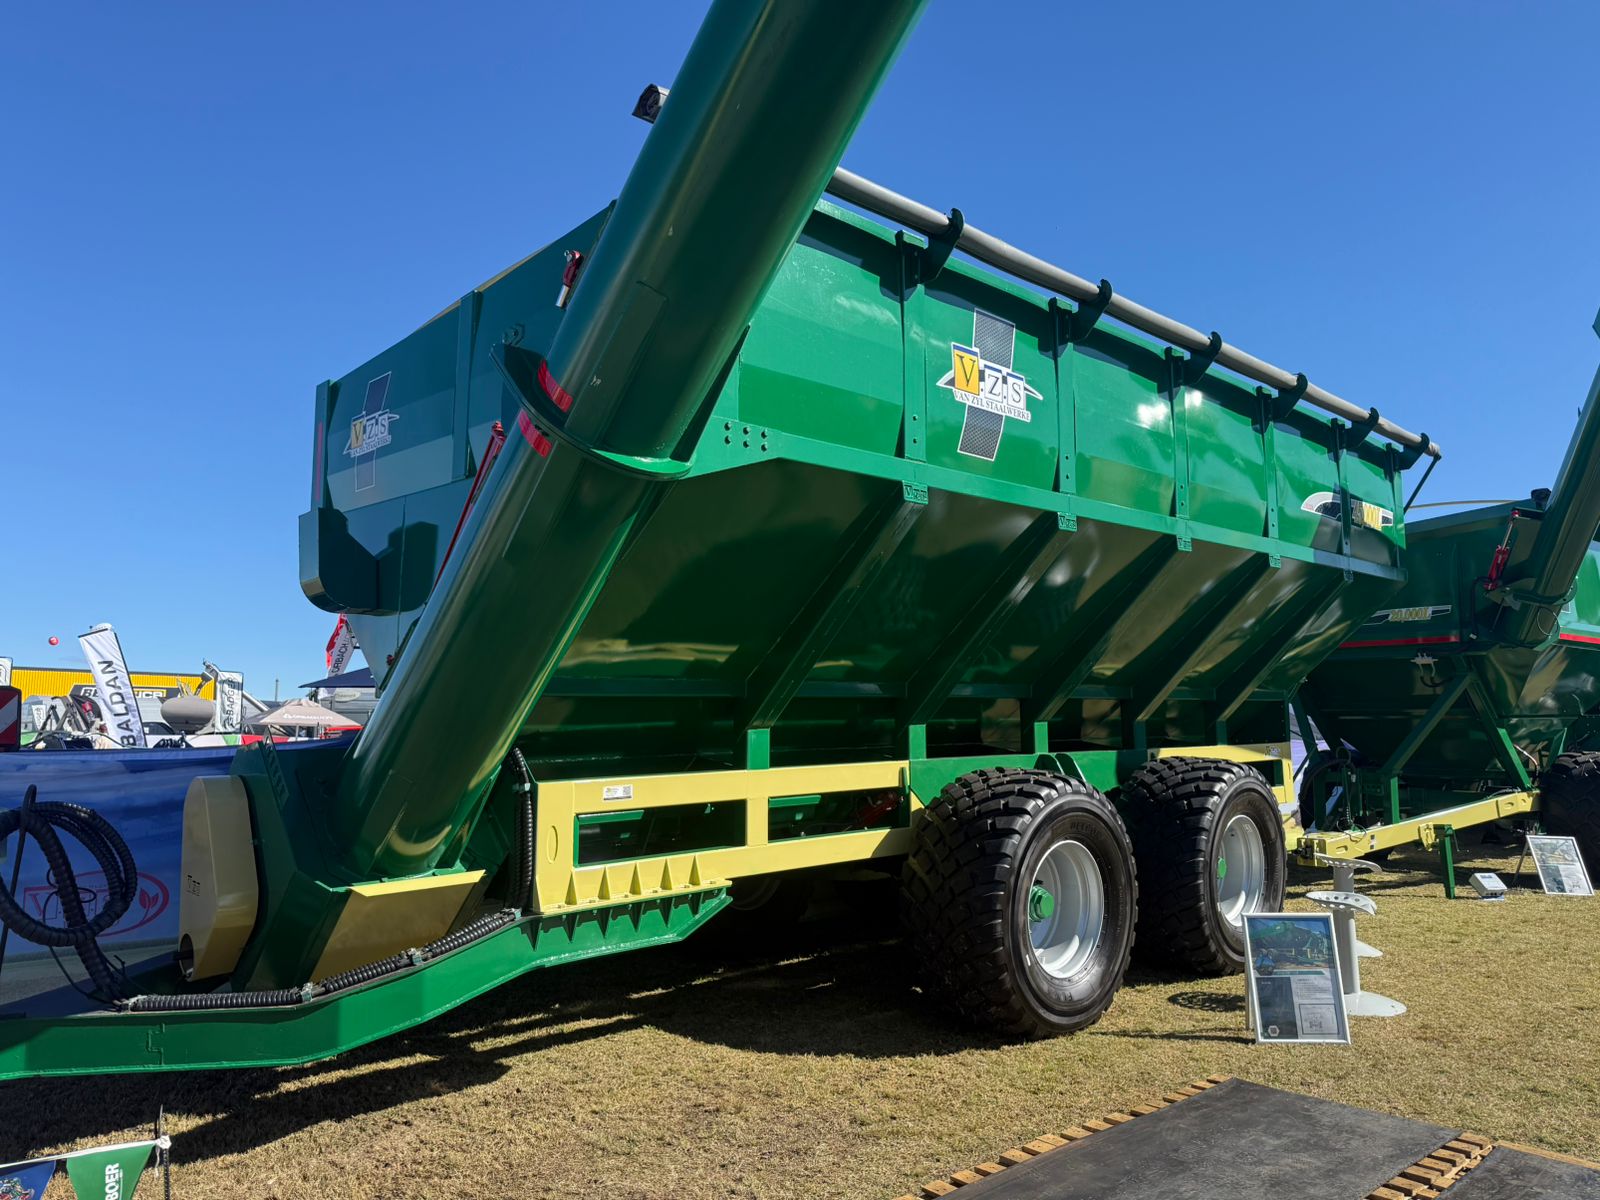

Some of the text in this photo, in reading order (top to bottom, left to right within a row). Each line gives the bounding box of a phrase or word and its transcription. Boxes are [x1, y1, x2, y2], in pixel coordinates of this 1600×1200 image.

[954, 389, 970, 403] VAN
[971, 396, 985, 407] ZYL
[97, 660, 137, 748] BALDAN
[105, 1162, 119, 1200] BOER
